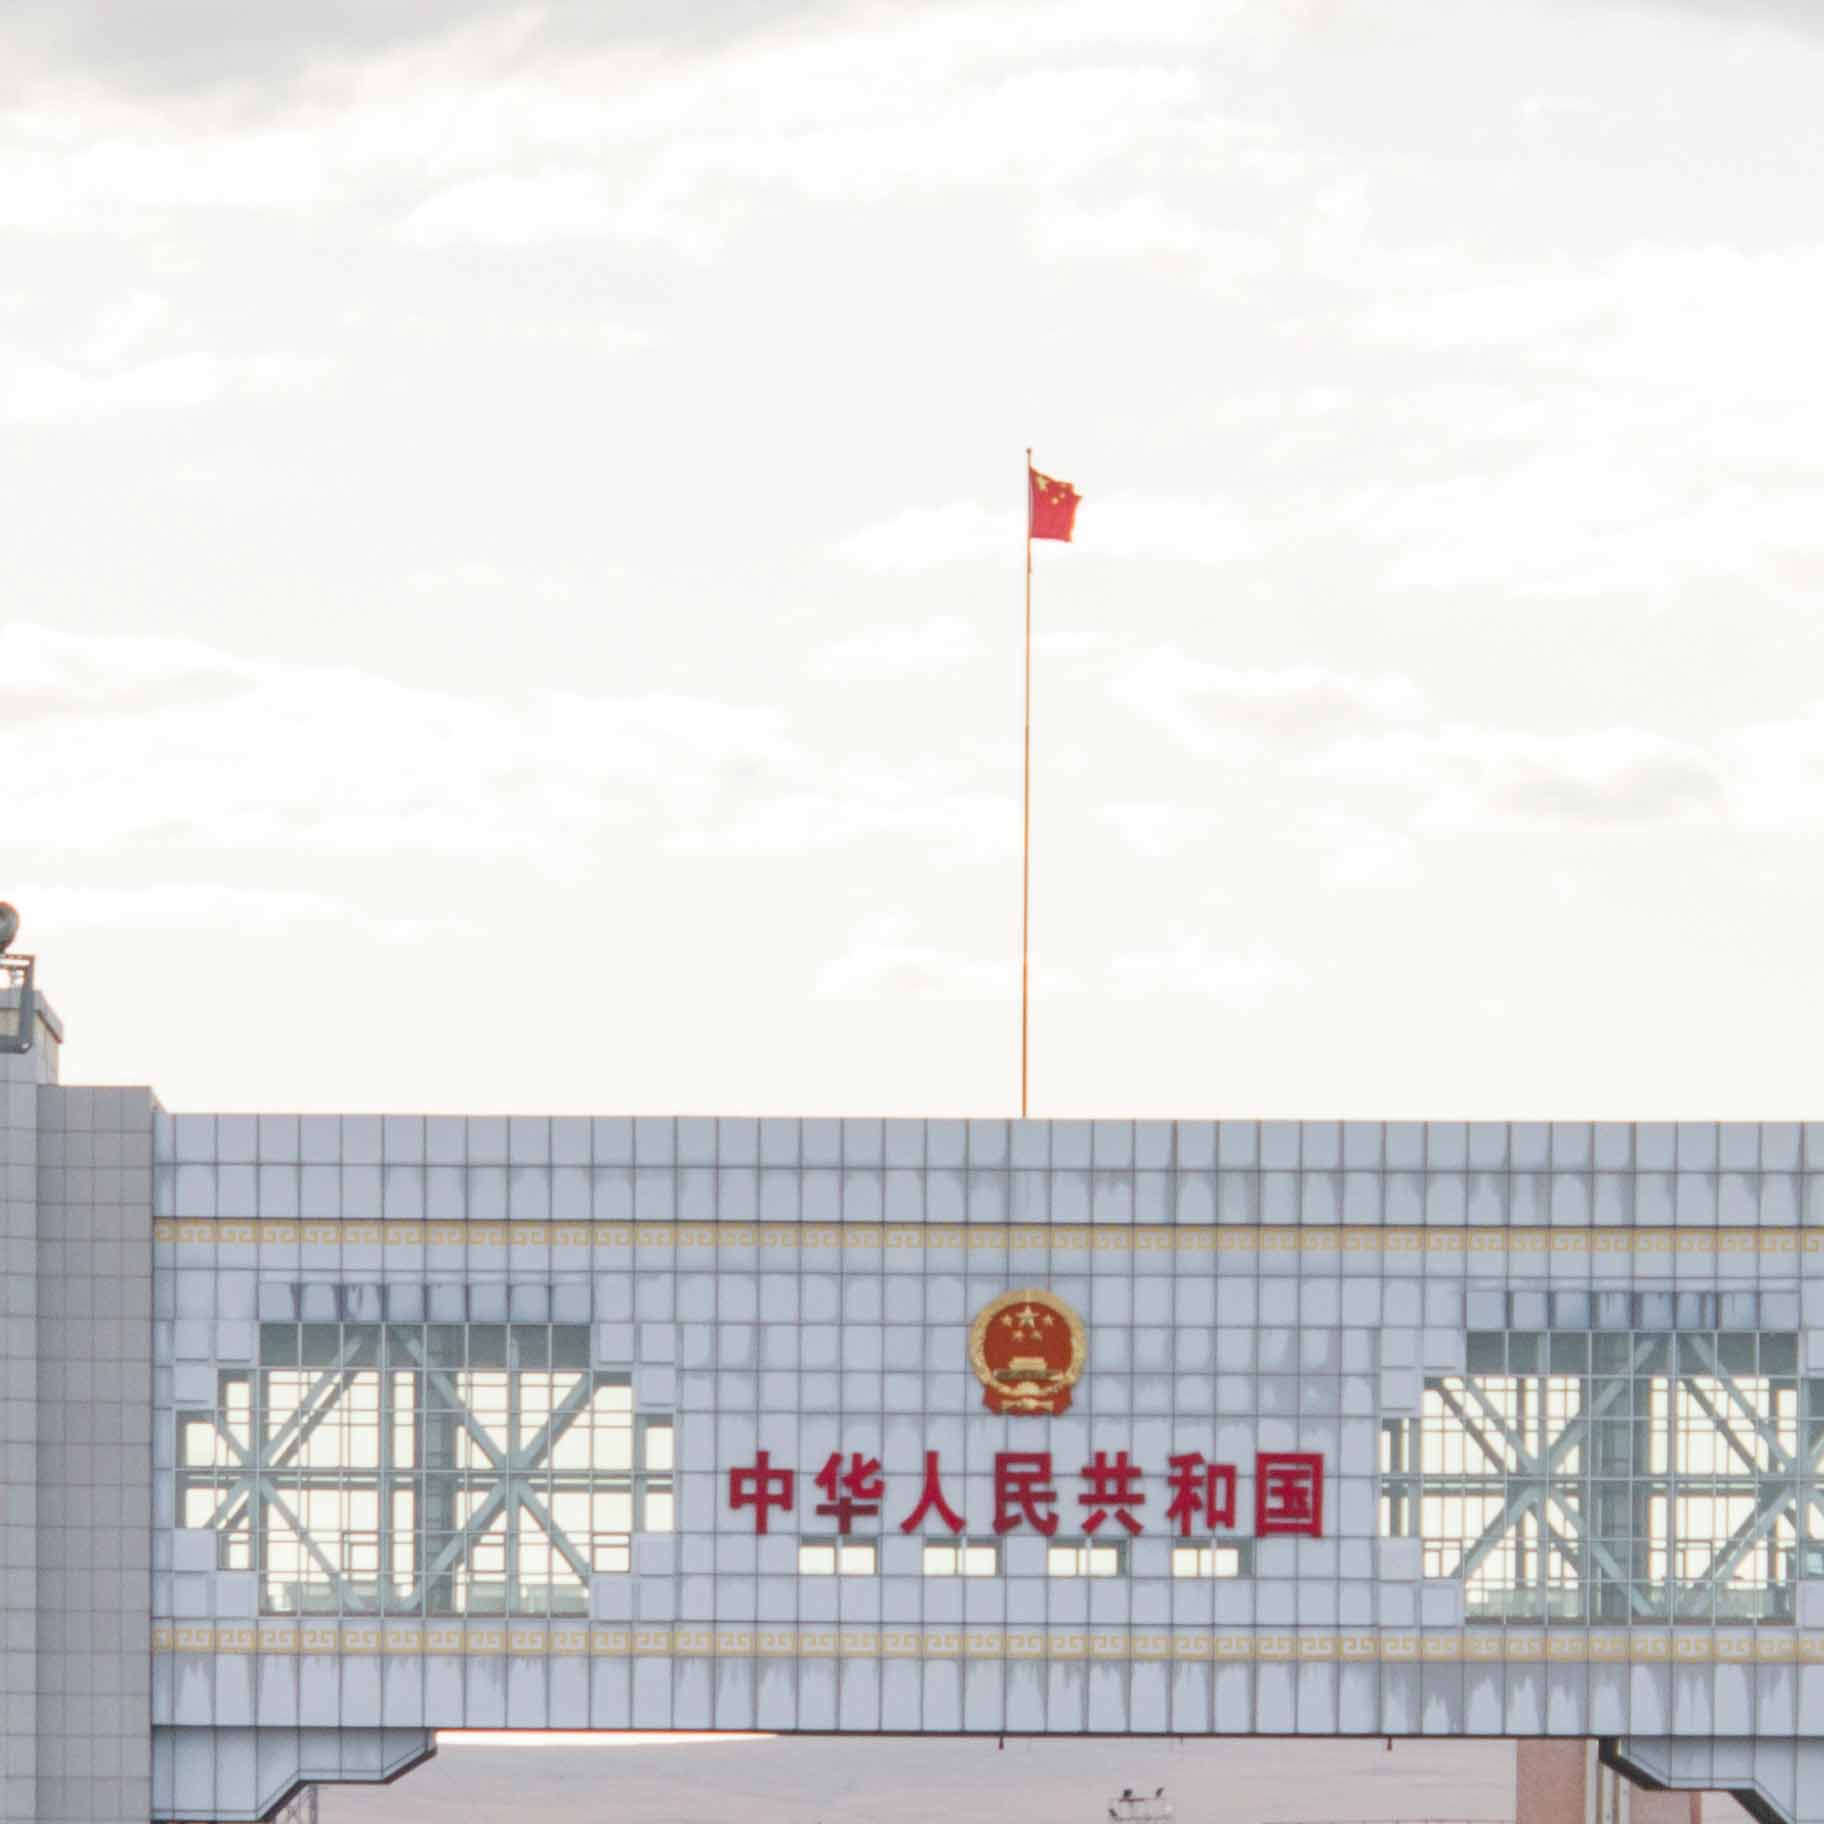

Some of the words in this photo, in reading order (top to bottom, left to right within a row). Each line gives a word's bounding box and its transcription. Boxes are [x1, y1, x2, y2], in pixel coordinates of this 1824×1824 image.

[728, 1449, 1324, 1538] 中华人民共和国
